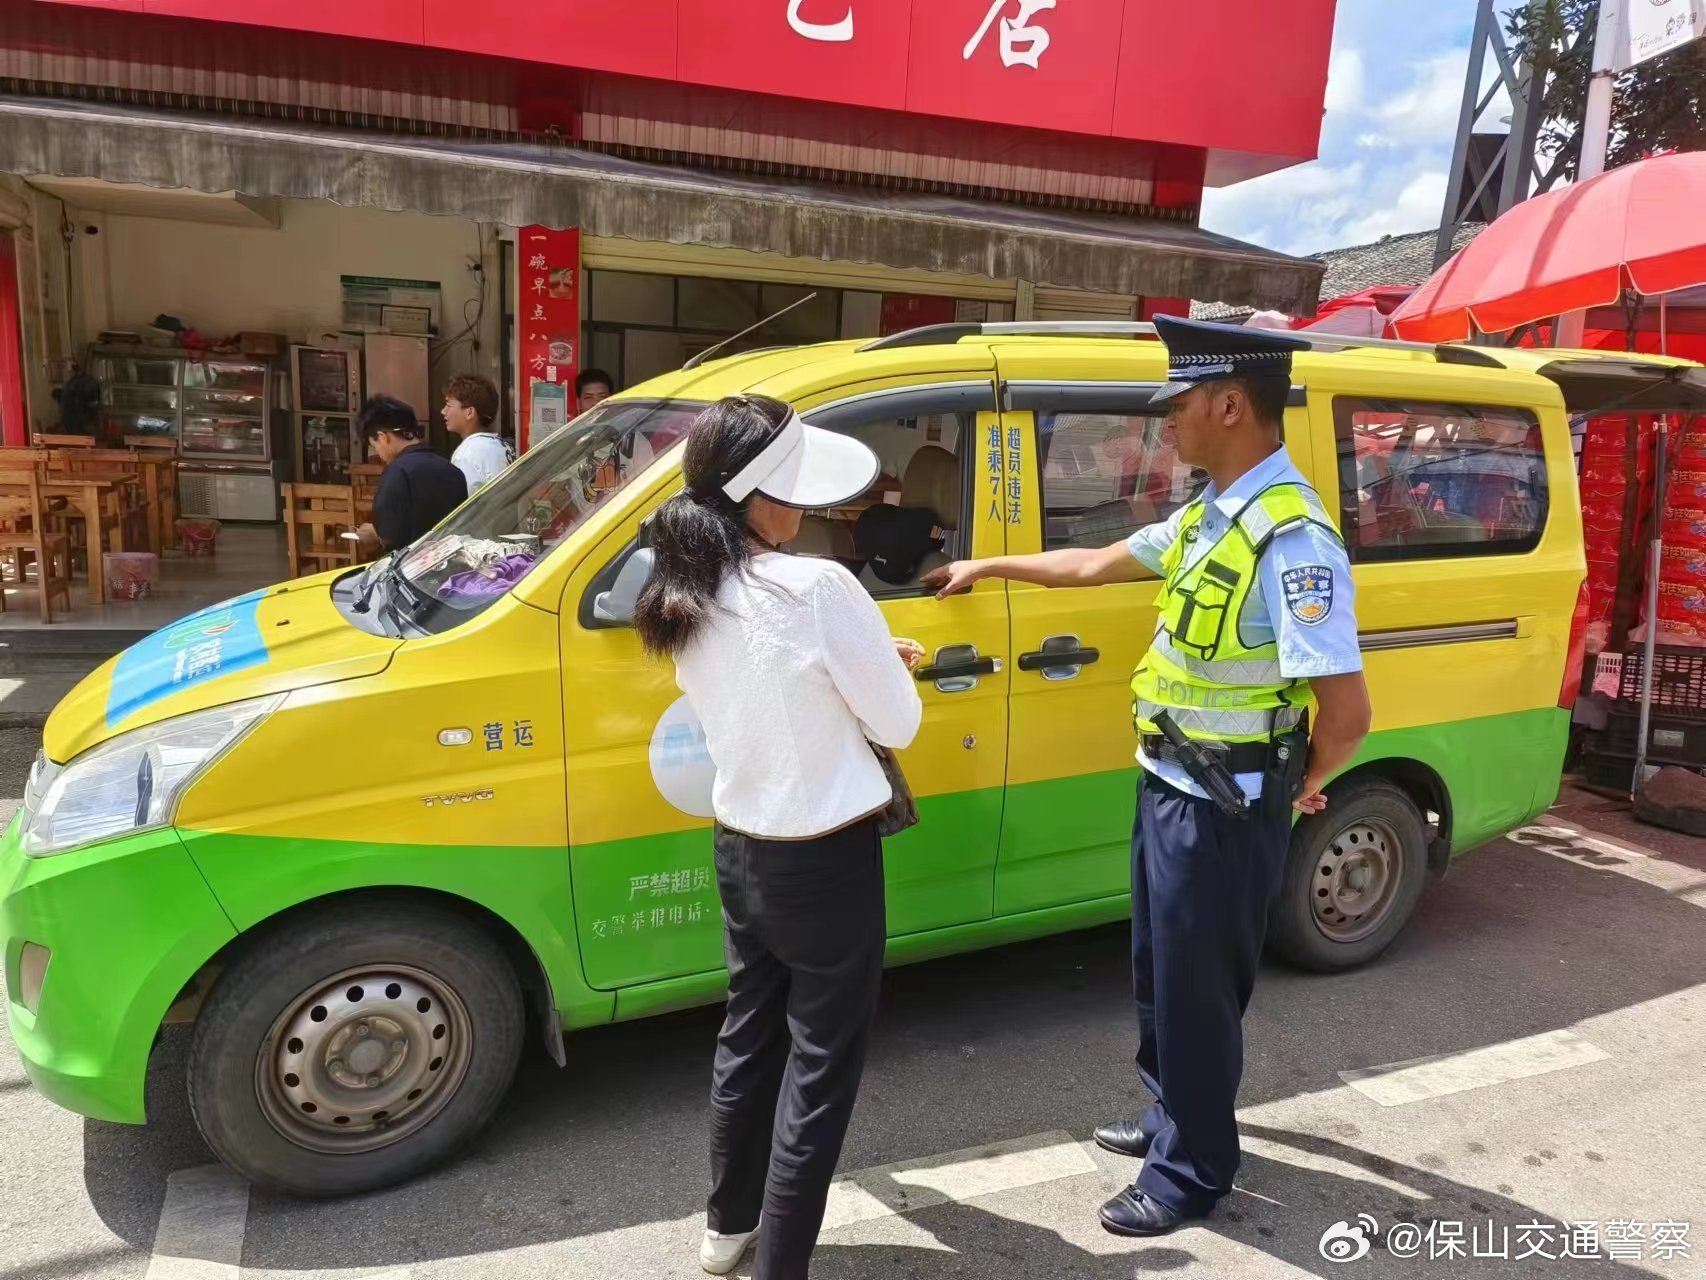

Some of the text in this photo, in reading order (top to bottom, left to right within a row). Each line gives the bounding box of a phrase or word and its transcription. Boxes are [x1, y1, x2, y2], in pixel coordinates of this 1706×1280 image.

[528, 235, 548, 384] 一碗早点八方
[987, 424, 1002, 523] 准乘7人
[1007, 426, 1021, 525] 超员违法
[1154, 674, 1249, 708] POLICE
[483, 719, 534, 752] 营运
[629, 865, 709, 901] 严禁超员
